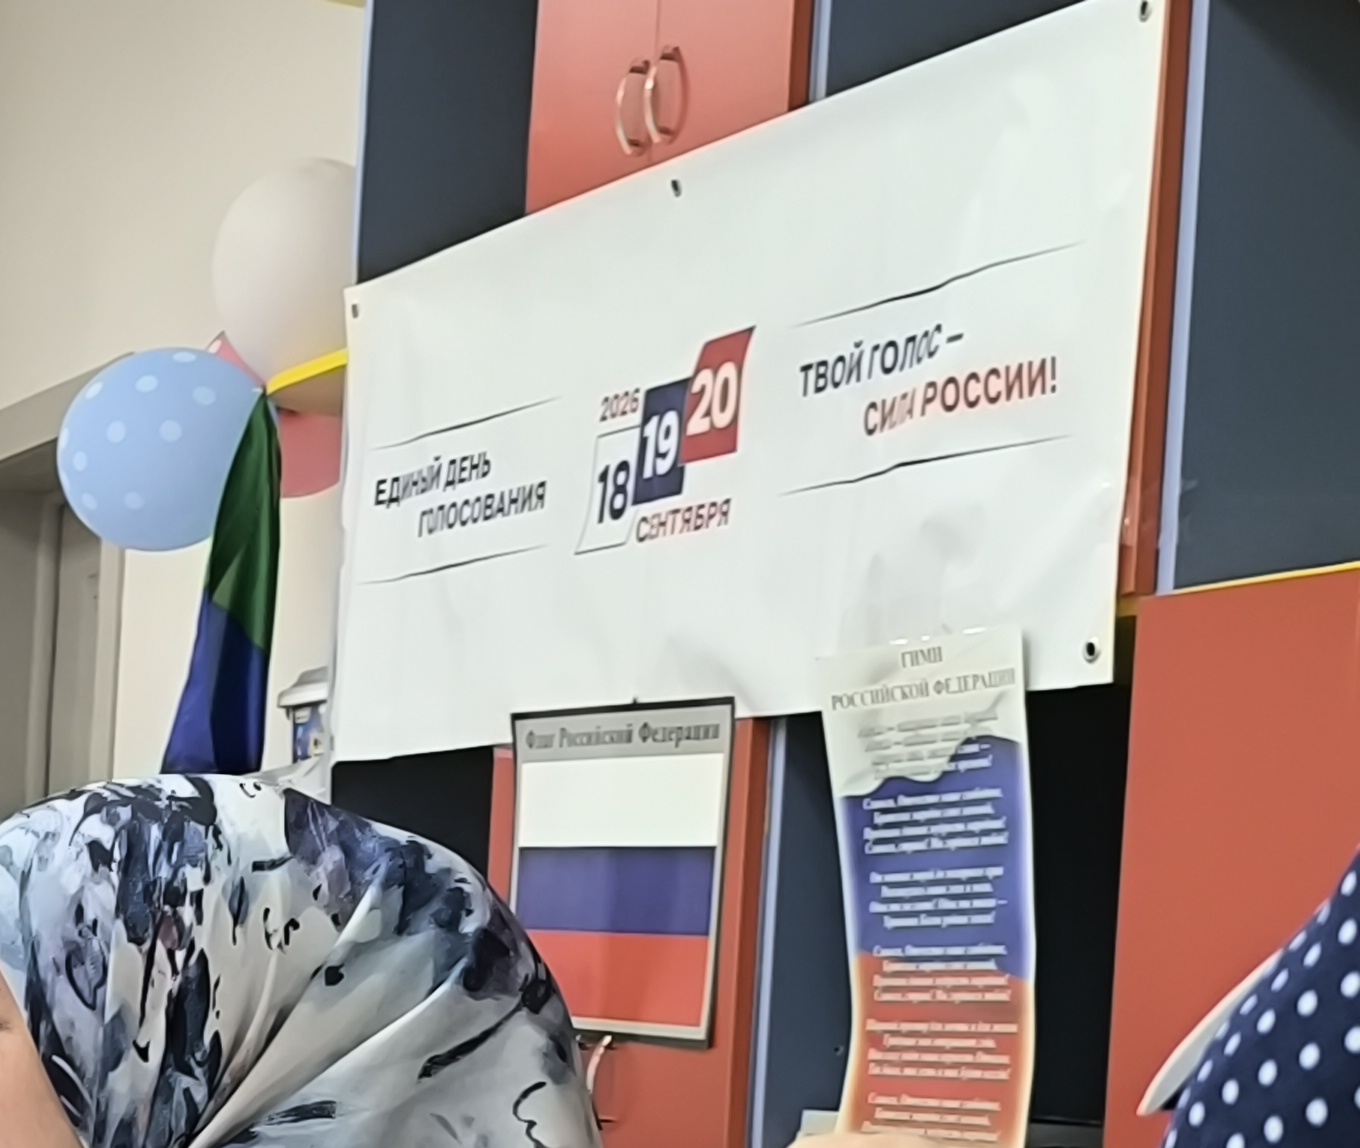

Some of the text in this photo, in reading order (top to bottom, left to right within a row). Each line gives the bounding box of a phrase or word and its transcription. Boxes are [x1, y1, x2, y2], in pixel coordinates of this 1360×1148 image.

[799, 340, 864, 397] ТВОЙ
[867, 324, 942, 380] ГОЛОС
[599, 388, 640, 422] 2026
[686, 361, 738, 436] 20
[864, 356, 1057, 436] СИЛА РОССИИ!
[643, 410, 679, 479] 19
[374, 451, 492, 509] ЕДИНЫЙ ДЕНЬ
[418, 480, 547, 538] ГОЛОСОВАНИЯ
[597, 460, 630, 524] 18
[636, 498, 731, 543] СЕНТЯБРЯ
[901, 646, 943, 668] ГИМН
[832, 668, 1016, 710] РОССИЙСКОЙ ФЕДЕРАЦИИ
